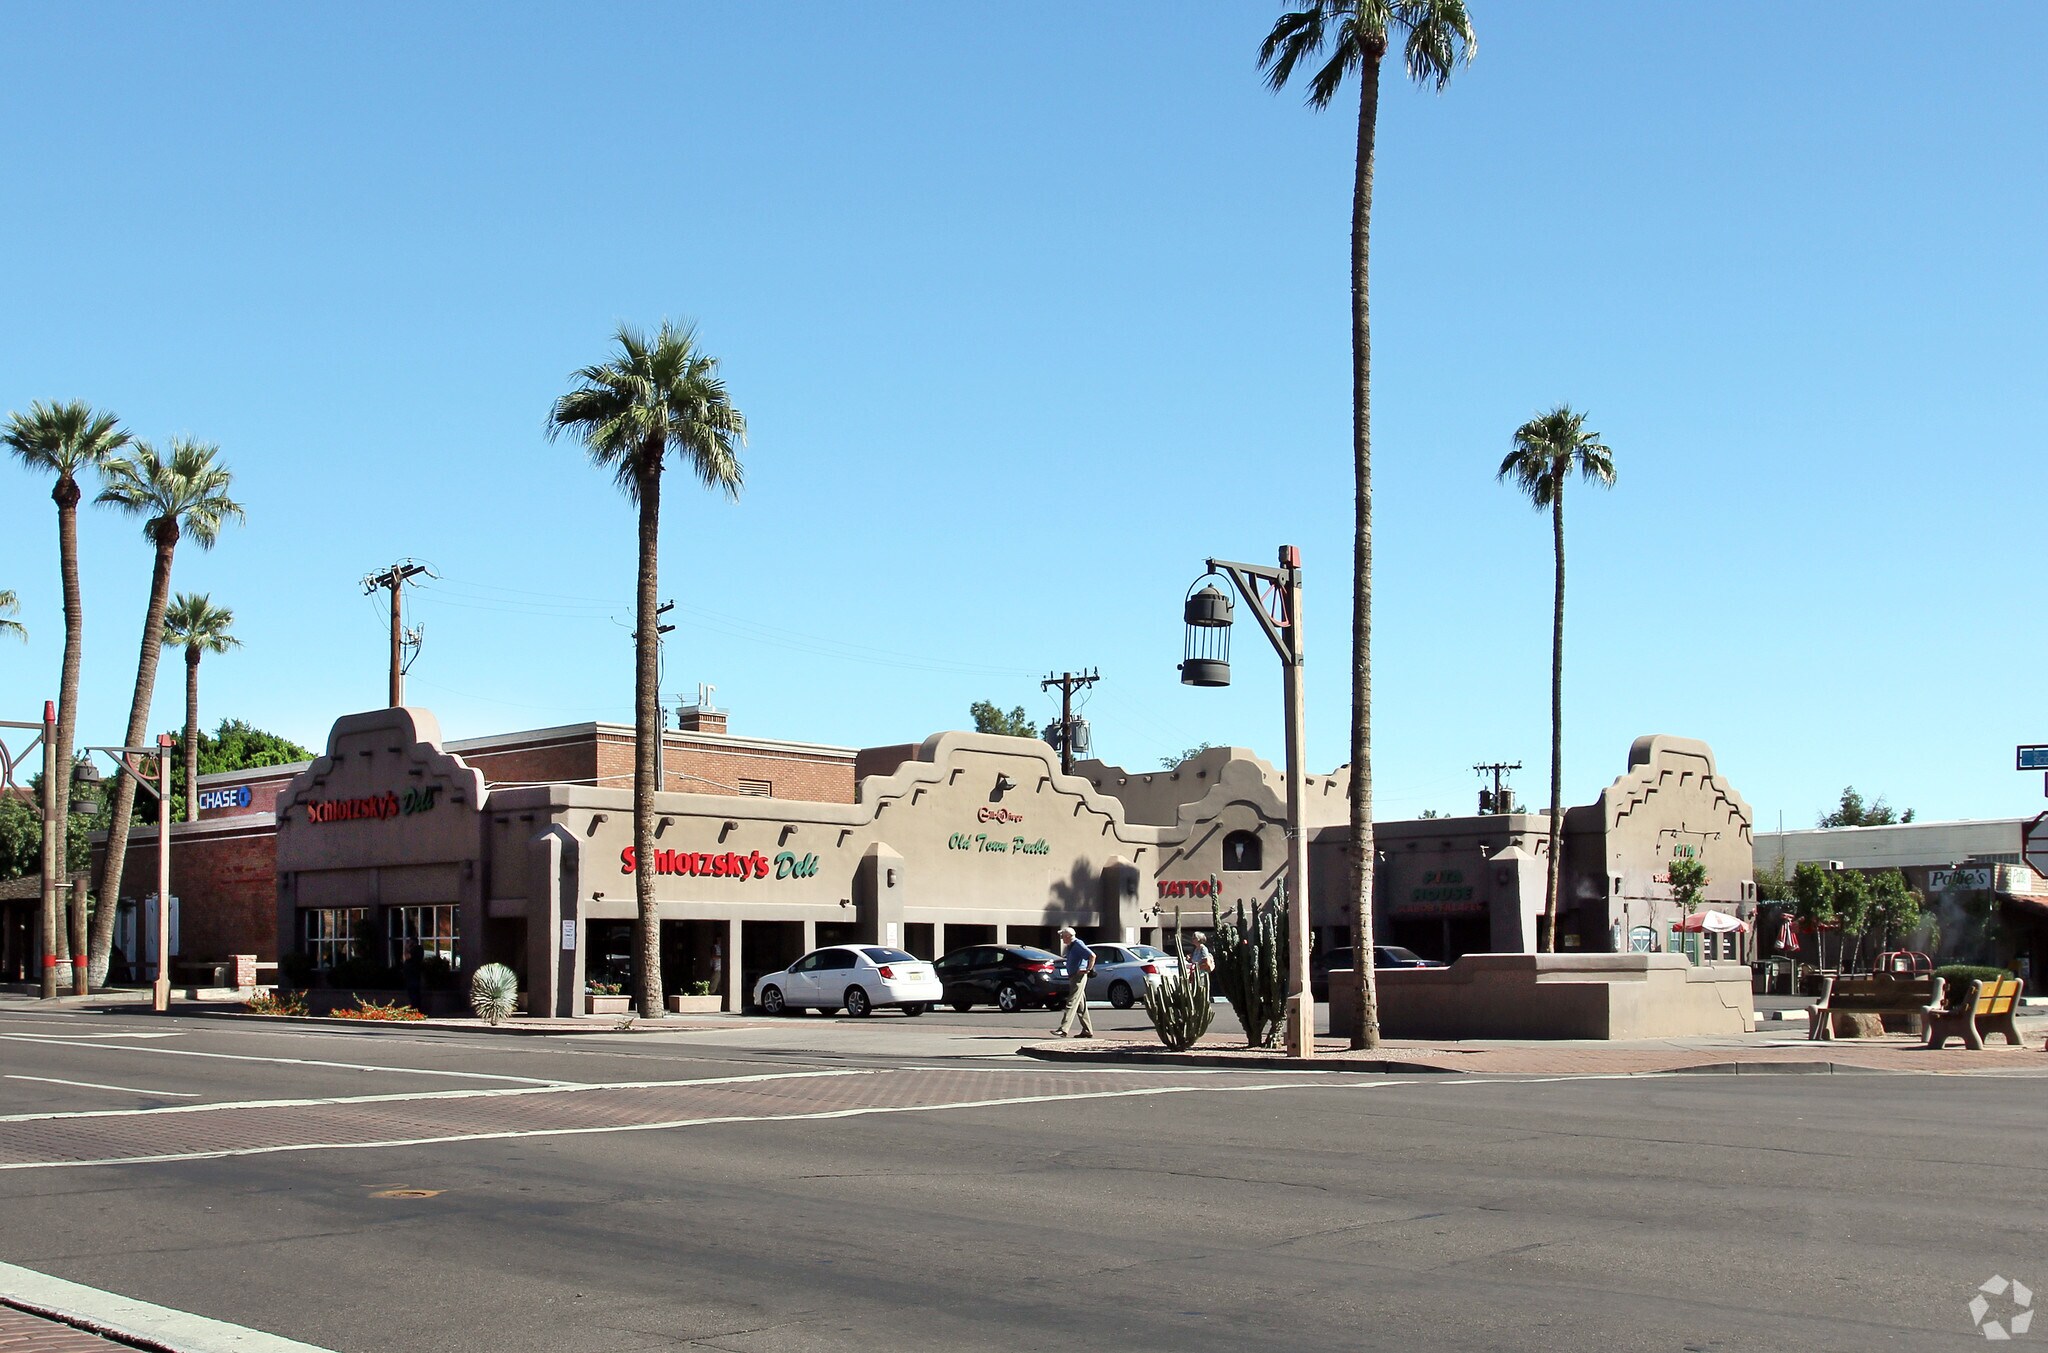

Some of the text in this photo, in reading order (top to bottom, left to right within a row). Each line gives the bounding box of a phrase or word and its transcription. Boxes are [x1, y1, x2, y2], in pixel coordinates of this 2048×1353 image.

[199, 789, 238, 810] CHASE
[308, 785, 436, 823] Schlotzsky's Deli
[948, 832, 972, 850] Old
[975, 833, 1008, 853] Town
[620, 846, 820, 882] Shlotzsky's Deli
[1424, 870, 1463, 884] PITA
